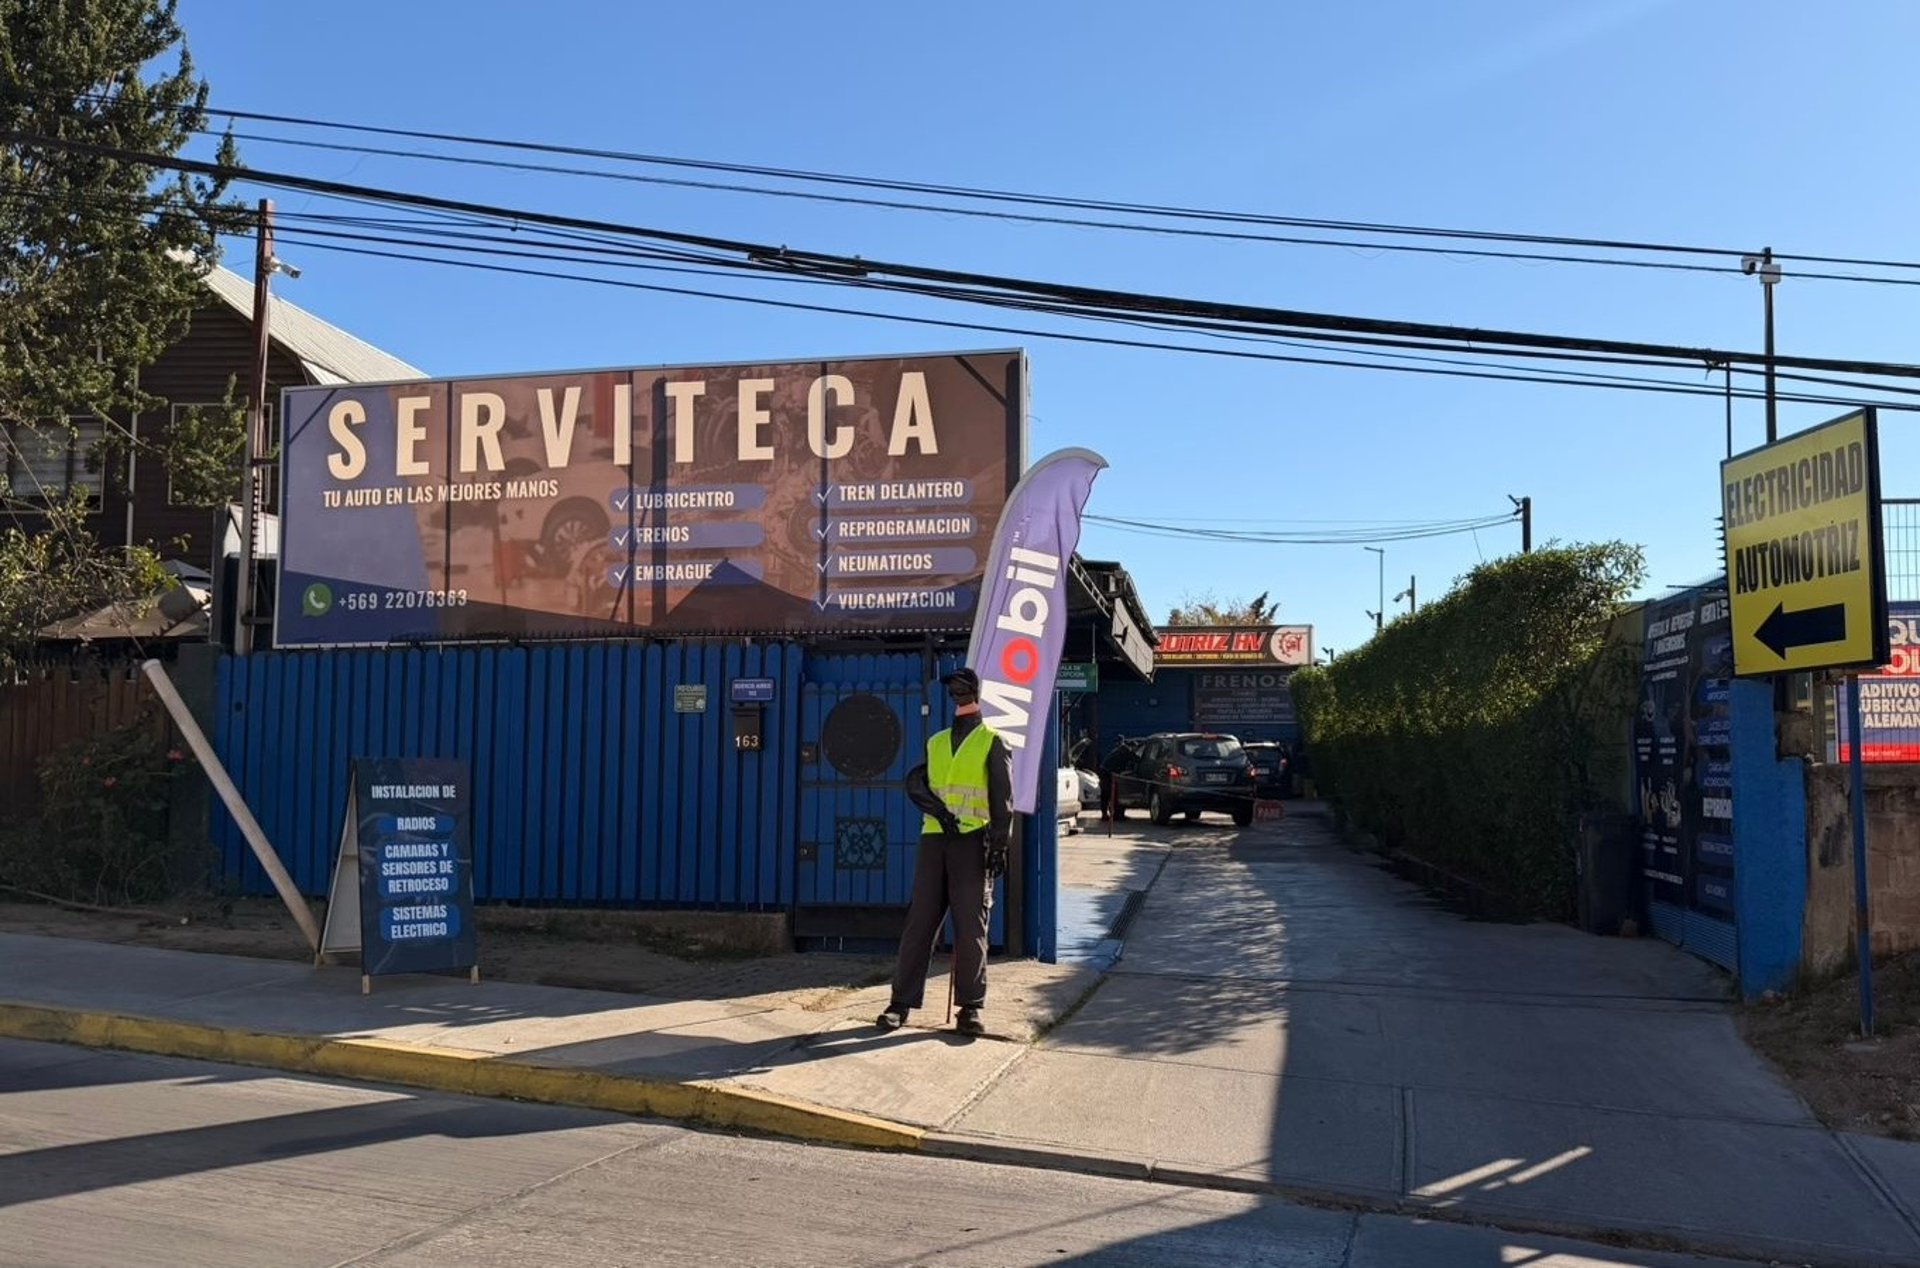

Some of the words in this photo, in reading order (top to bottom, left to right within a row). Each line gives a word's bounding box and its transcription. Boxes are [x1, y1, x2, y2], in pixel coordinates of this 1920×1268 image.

[327, 371, 939, 480] SERVITECA
[323, 491, 340, 507] TU
[345, 489, 381, 506] AUTO
[386, 487, 403, 504] EN
[408, 486, 434, 503] LAS
[438, 482, 501, 502] MEJORES
[506, 480, 559, 498] MANOS
[839, 484, 875, 501] TREN
[881, 481, 964, 500] DELANTERO
[1727, 441, 1863, 528] ELECTRICIDAD
[636, 491, 734, 509] LUBRICENTRO
[636, 526, 689, 543] FRENOS
[839, 517, 971, 537] REPROGRAMACION
[838, 554, 933, 572] NEUMATICOS
[1736, 519, 1860, 594] AUTOMOTRIZ
[635, 563, 713, 581] EMBRAGUE
[339, 593, 377, 610] +569
[385, 589, 467, 609] 22078363
[839, 591, 955, 610] VULCANIZACION
[981, 547, 1059, 749] Mobil
[1202, 675, 1290, 687] FRENOS
[735, 735, 759, 748] 163
[371, 785, 439, 799] INSTALACION
[442, 784, 456, 798] DE
[397, 817, 436, 831] RADIOS
[385, 844, 439, 858] CAMARAS
[441, 843, 448, 856] Y
[382, 861, 437, 876] SENSORES
[439, 860, 453, 874] DE
[388, 877, 449, 893] RETROCESO
[393, 905, 447, 920] SISTEMAS
[391, 922, 447, 939] ELECTRICO
